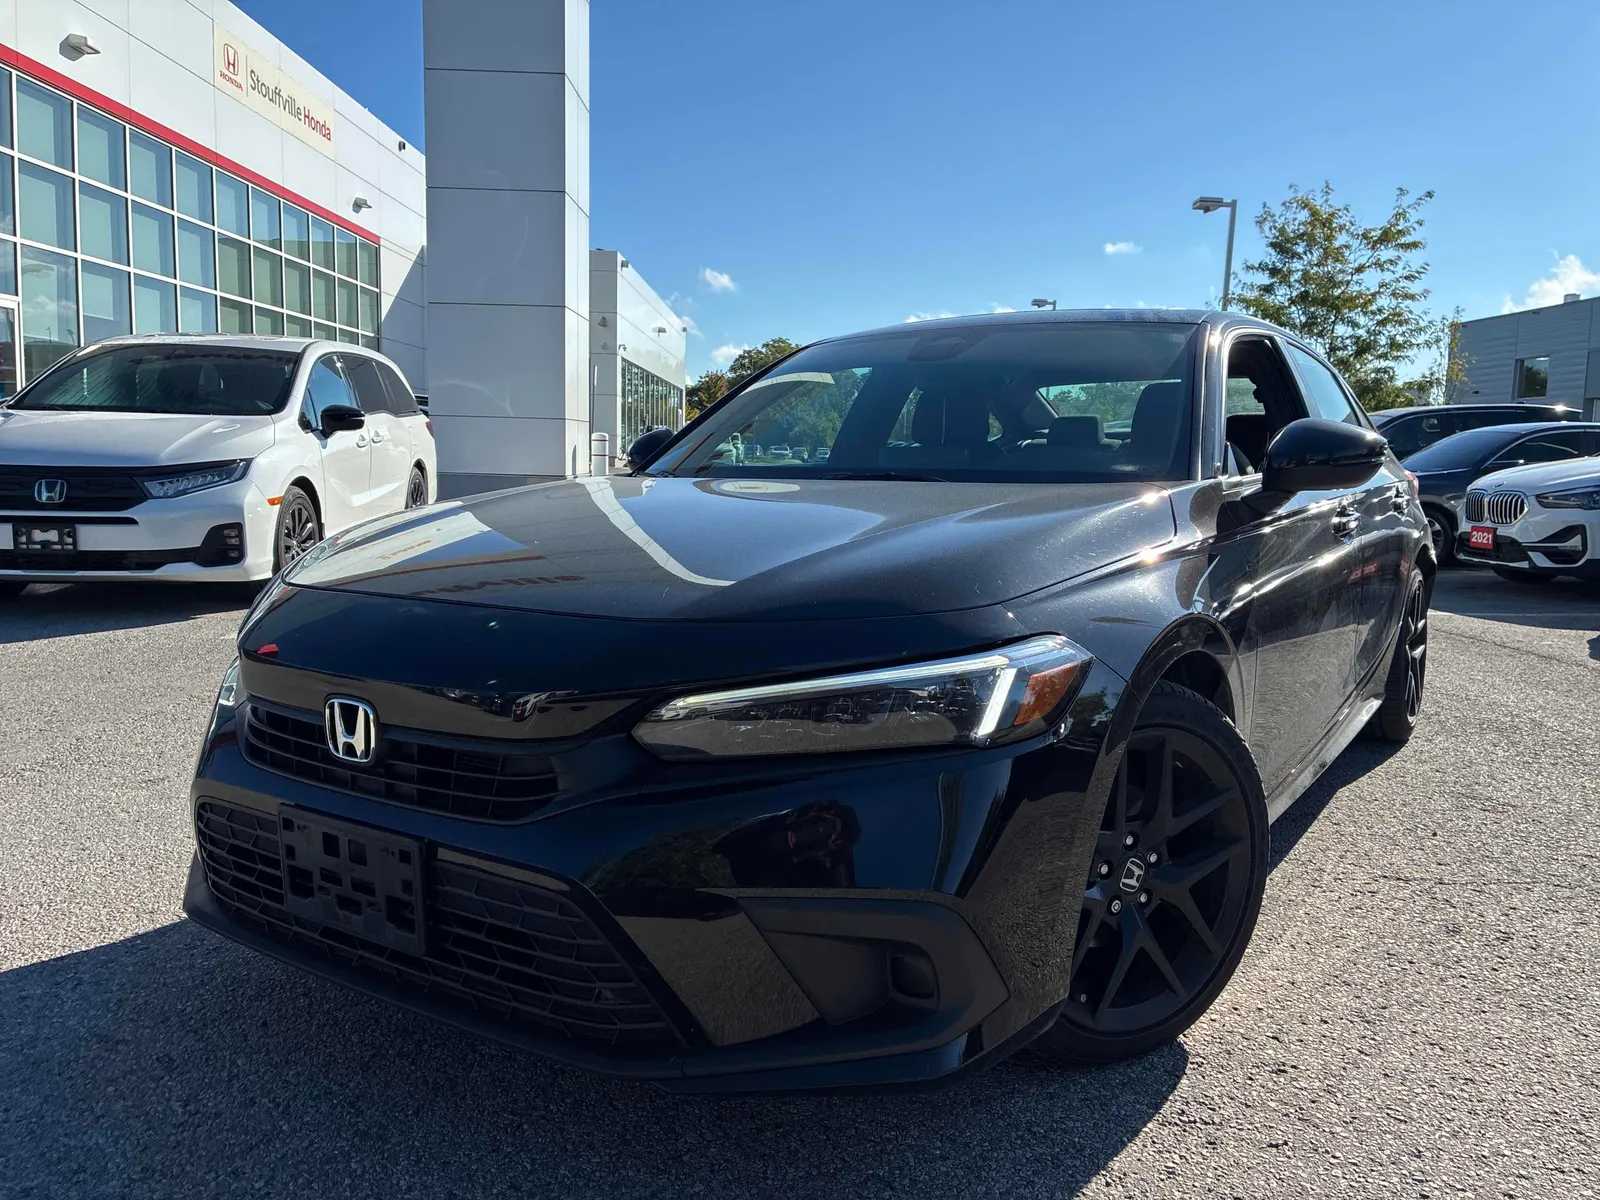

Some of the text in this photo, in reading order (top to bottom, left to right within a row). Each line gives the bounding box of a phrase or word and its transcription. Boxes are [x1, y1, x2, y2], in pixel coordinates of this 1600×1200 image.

[219, 70, 243, 91] HONDA
[250, 69, 331, 141] Stouffville Honda
[1471, 531, 1492, 544] 2021
